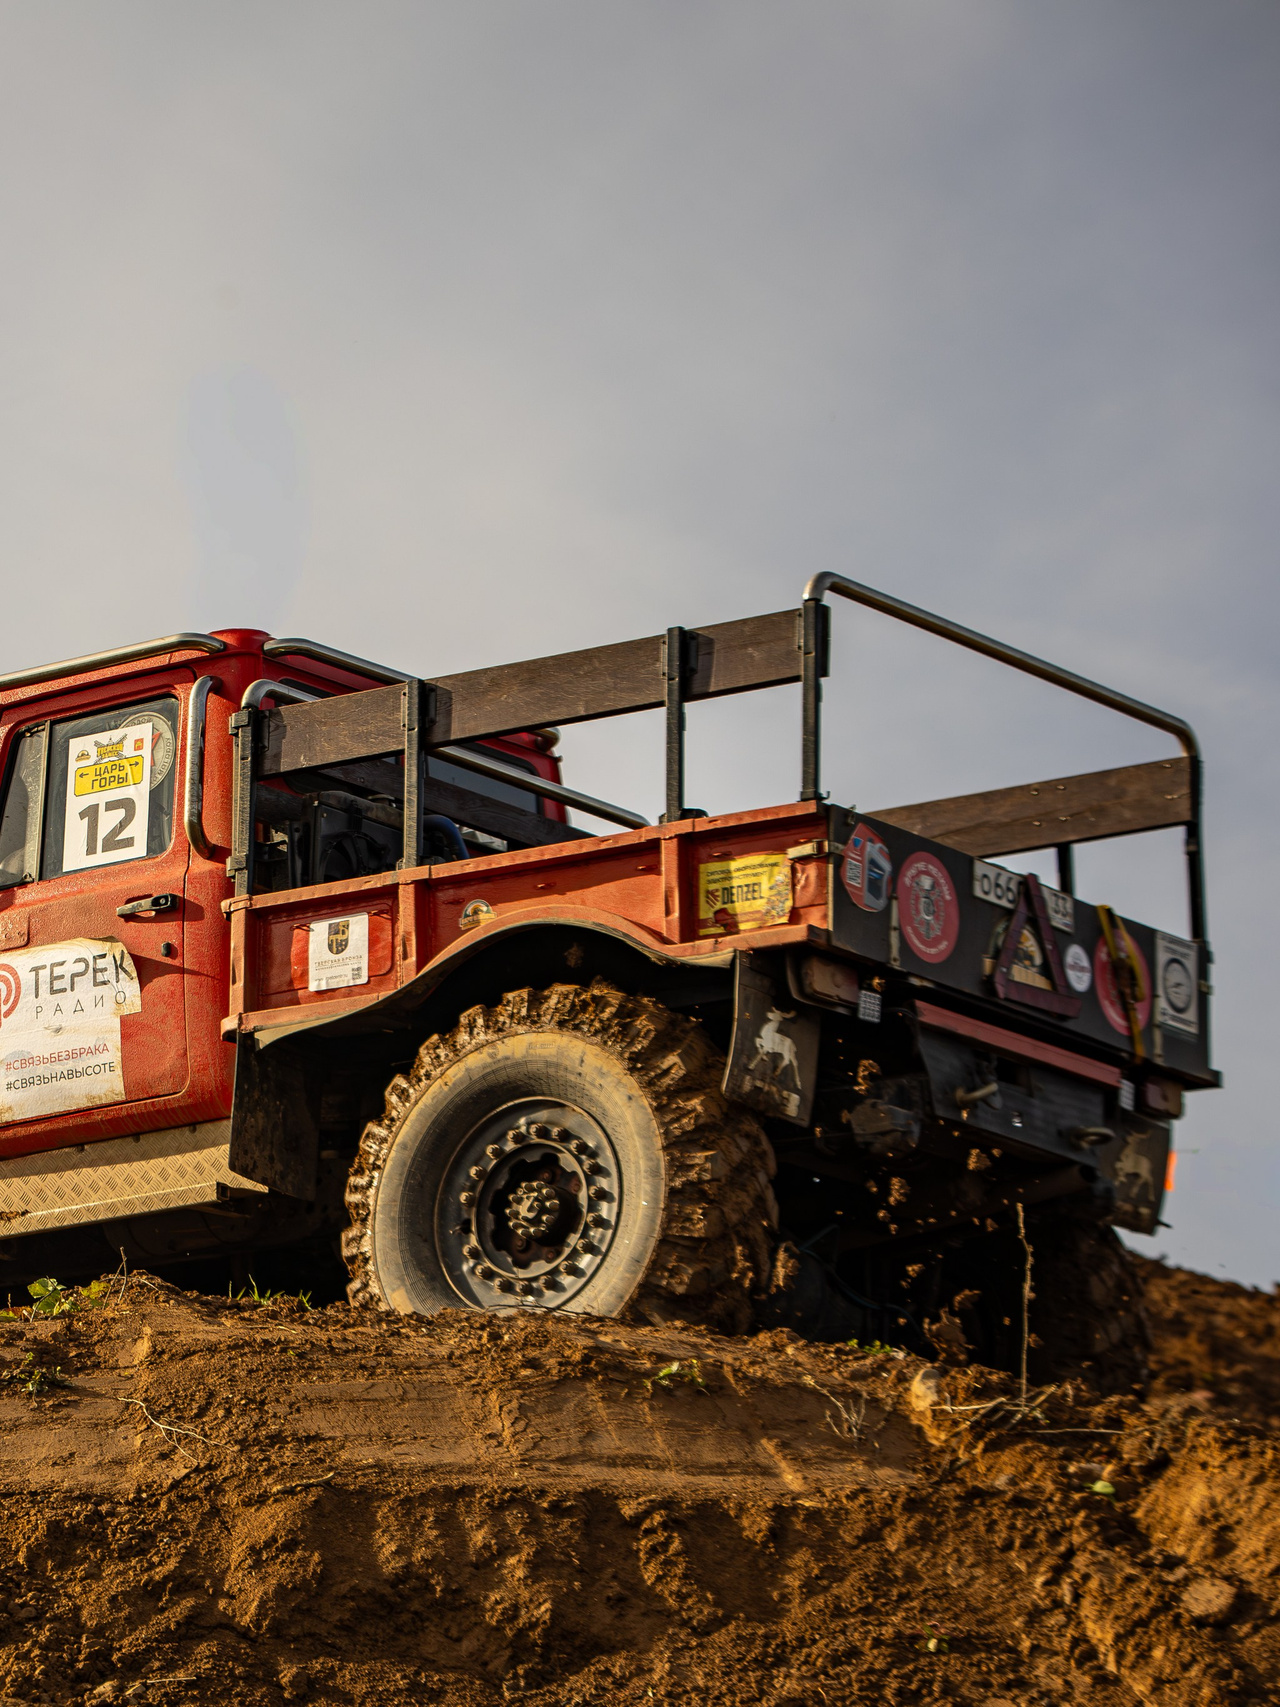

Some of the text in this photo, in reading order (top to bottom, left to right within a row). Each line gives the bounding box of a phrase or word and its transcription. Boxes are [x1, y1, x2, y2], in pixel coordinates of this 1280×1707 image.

[91, 772, 128, 790] ГОРЫ
[94, 761, 125, 777] ЦАРЬ
[78, 797, 137, 857] 12
[28, 949, 134, 999] ТЕРЕК
[35, 990, 127, 1020] РАДИО
[5, 1042, 110, 1073] #СВЯЗЬБЕЗБРАКА
[5, 1061, 116, 1092] #СВЯЗЬНАВЫСОТЕ
